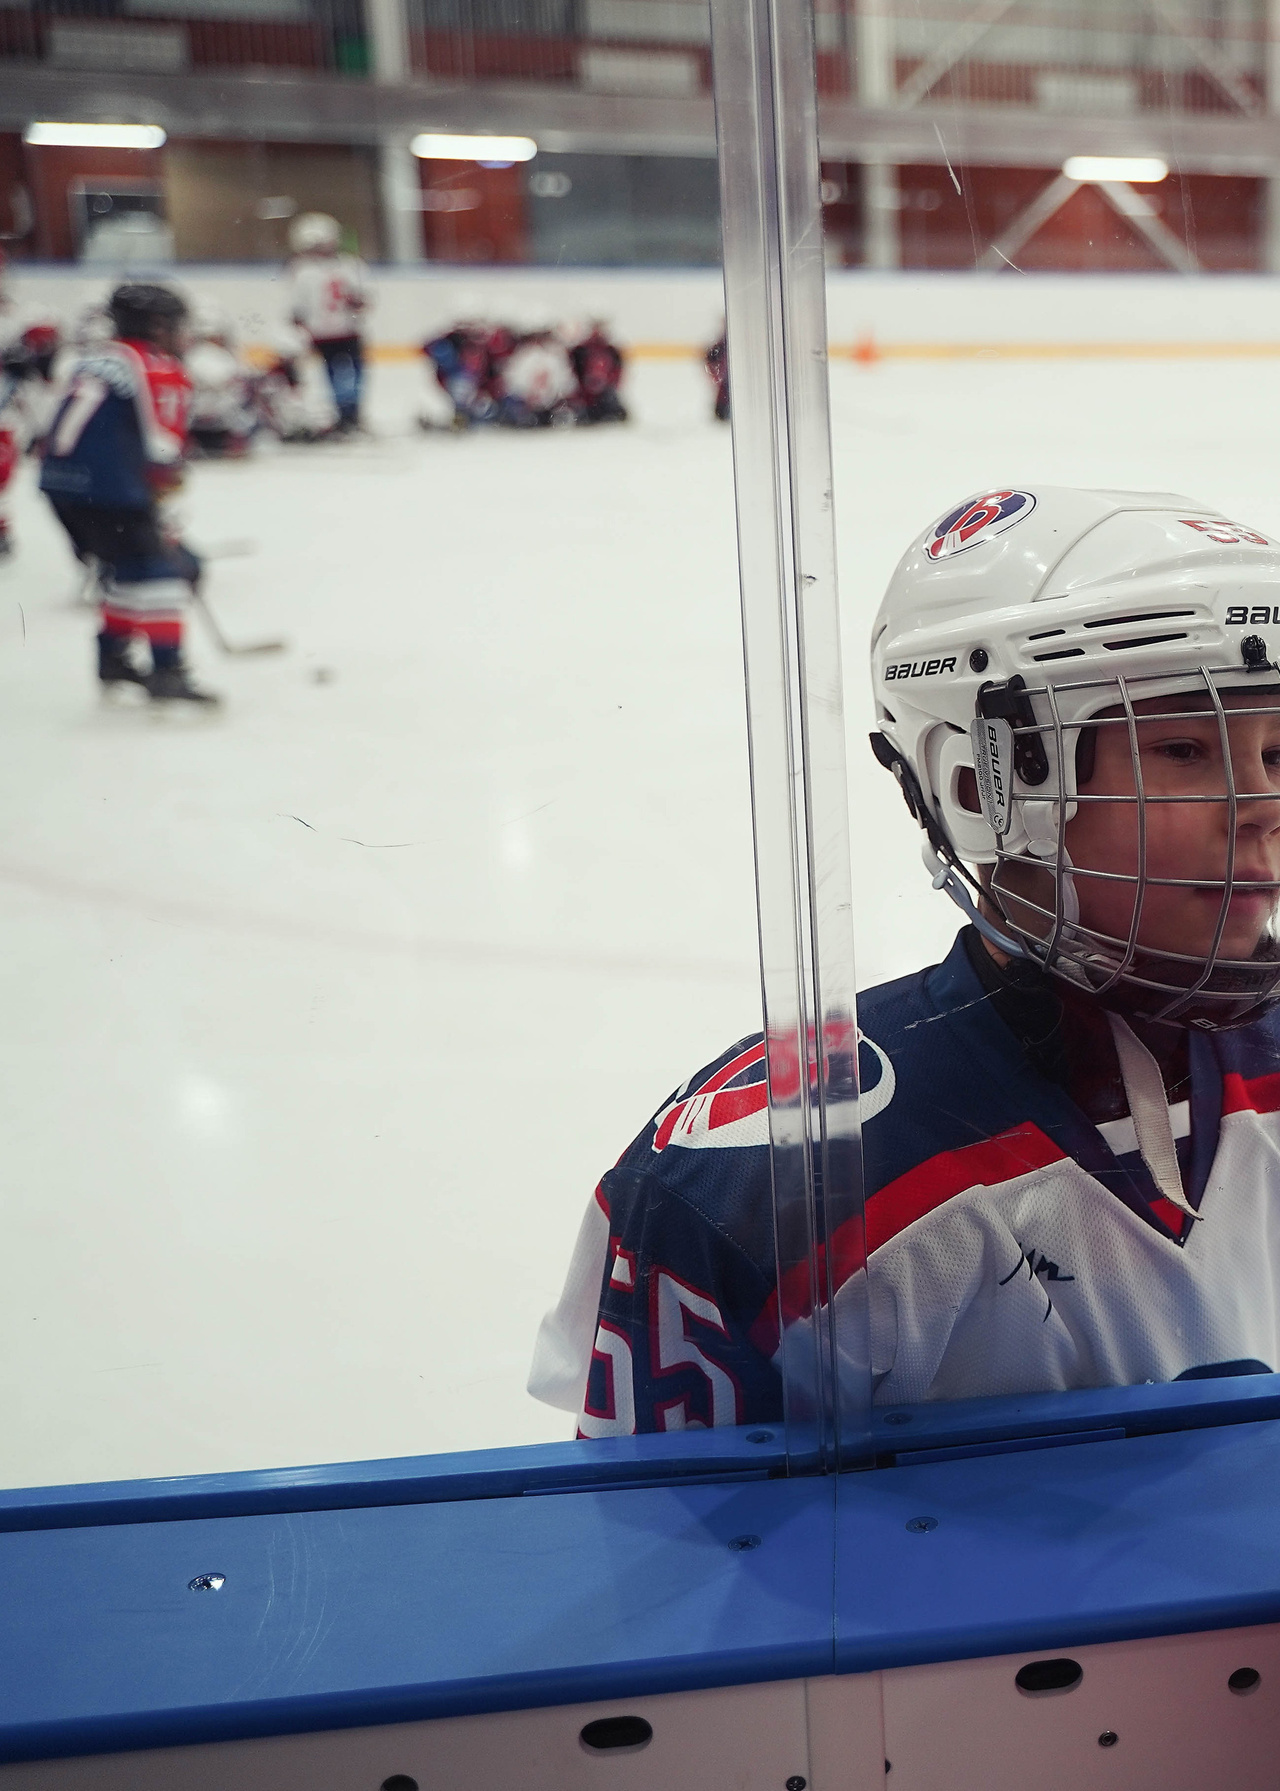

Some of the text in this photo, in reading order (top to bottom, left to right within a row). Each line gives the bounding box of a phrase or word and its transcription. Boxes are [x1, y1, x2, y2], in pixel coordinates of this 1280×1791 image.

[1177, 520, 1269, 545] 55
[884, 657, 957, 680] BAUER
[988, 725, 1005, 807] BAUER
